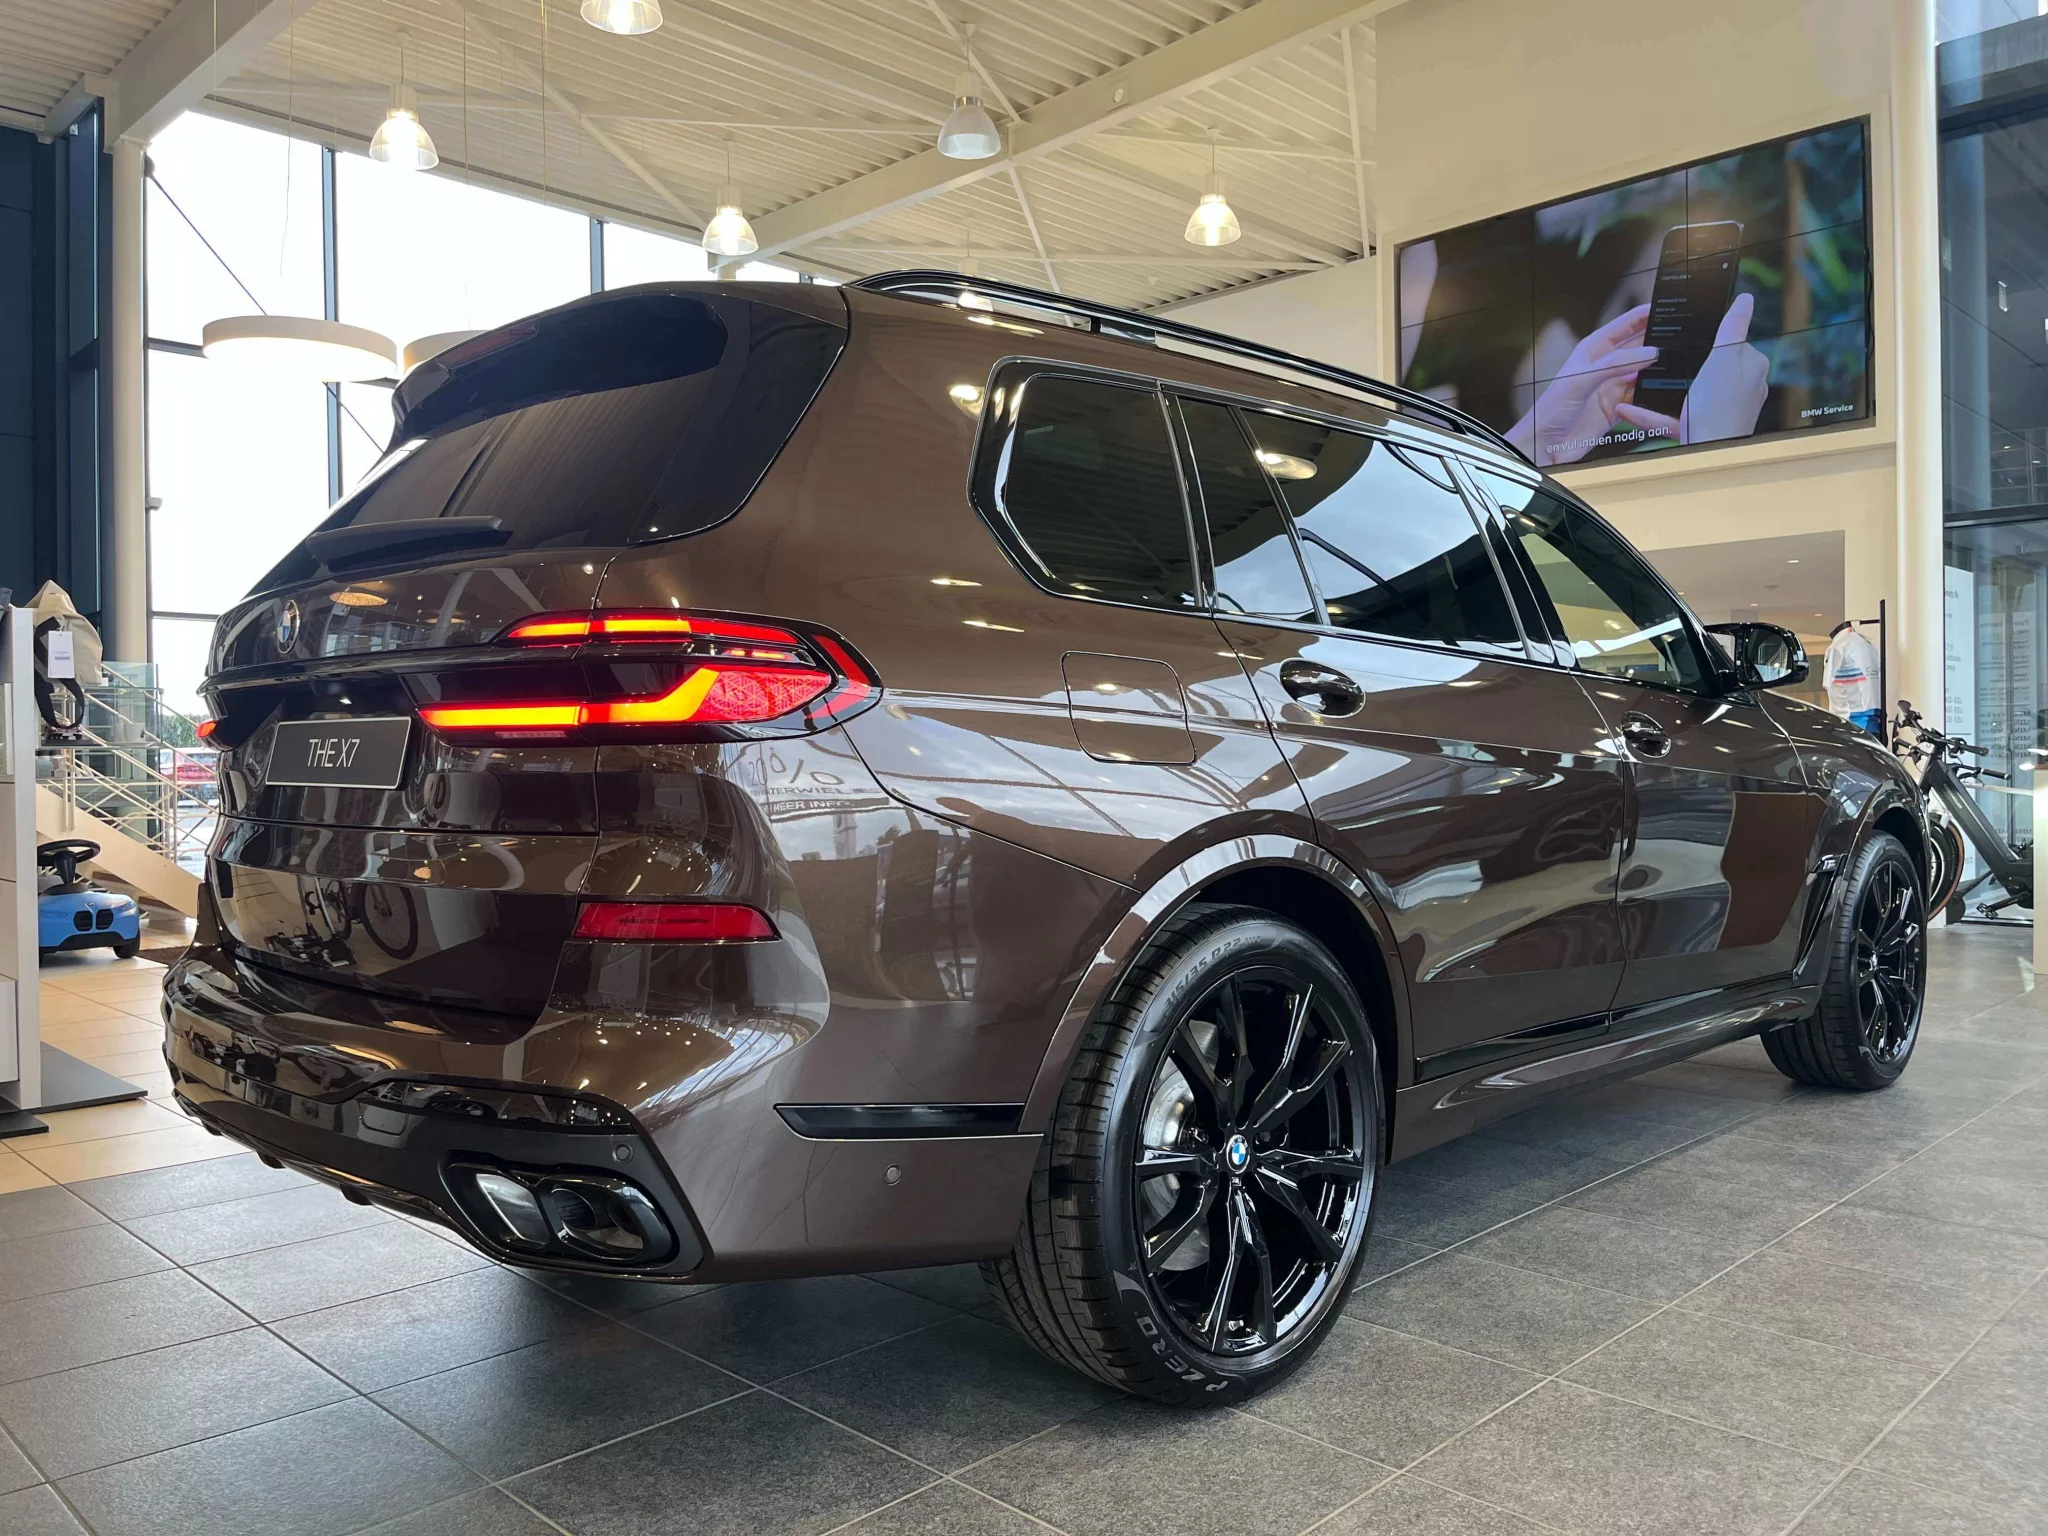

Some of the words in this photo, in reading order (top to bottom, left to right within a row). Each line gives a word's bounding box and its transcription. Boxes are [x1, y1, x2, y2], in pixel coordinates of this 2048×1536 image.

[1801, 408, 1822, 418] BMW
[1823, 404, 1854, 415] Service
[1547, 444, 1560, 453] en
[1561, 440, 1577, 451] vul
[1579, 435, 1612, 448] indien
[1614, 429, 1645, 443] nodig
[1647, 426, 1673, 437] aan.
[307, 738, 339, 767] THE
[336, 738, 361, 767] X7
